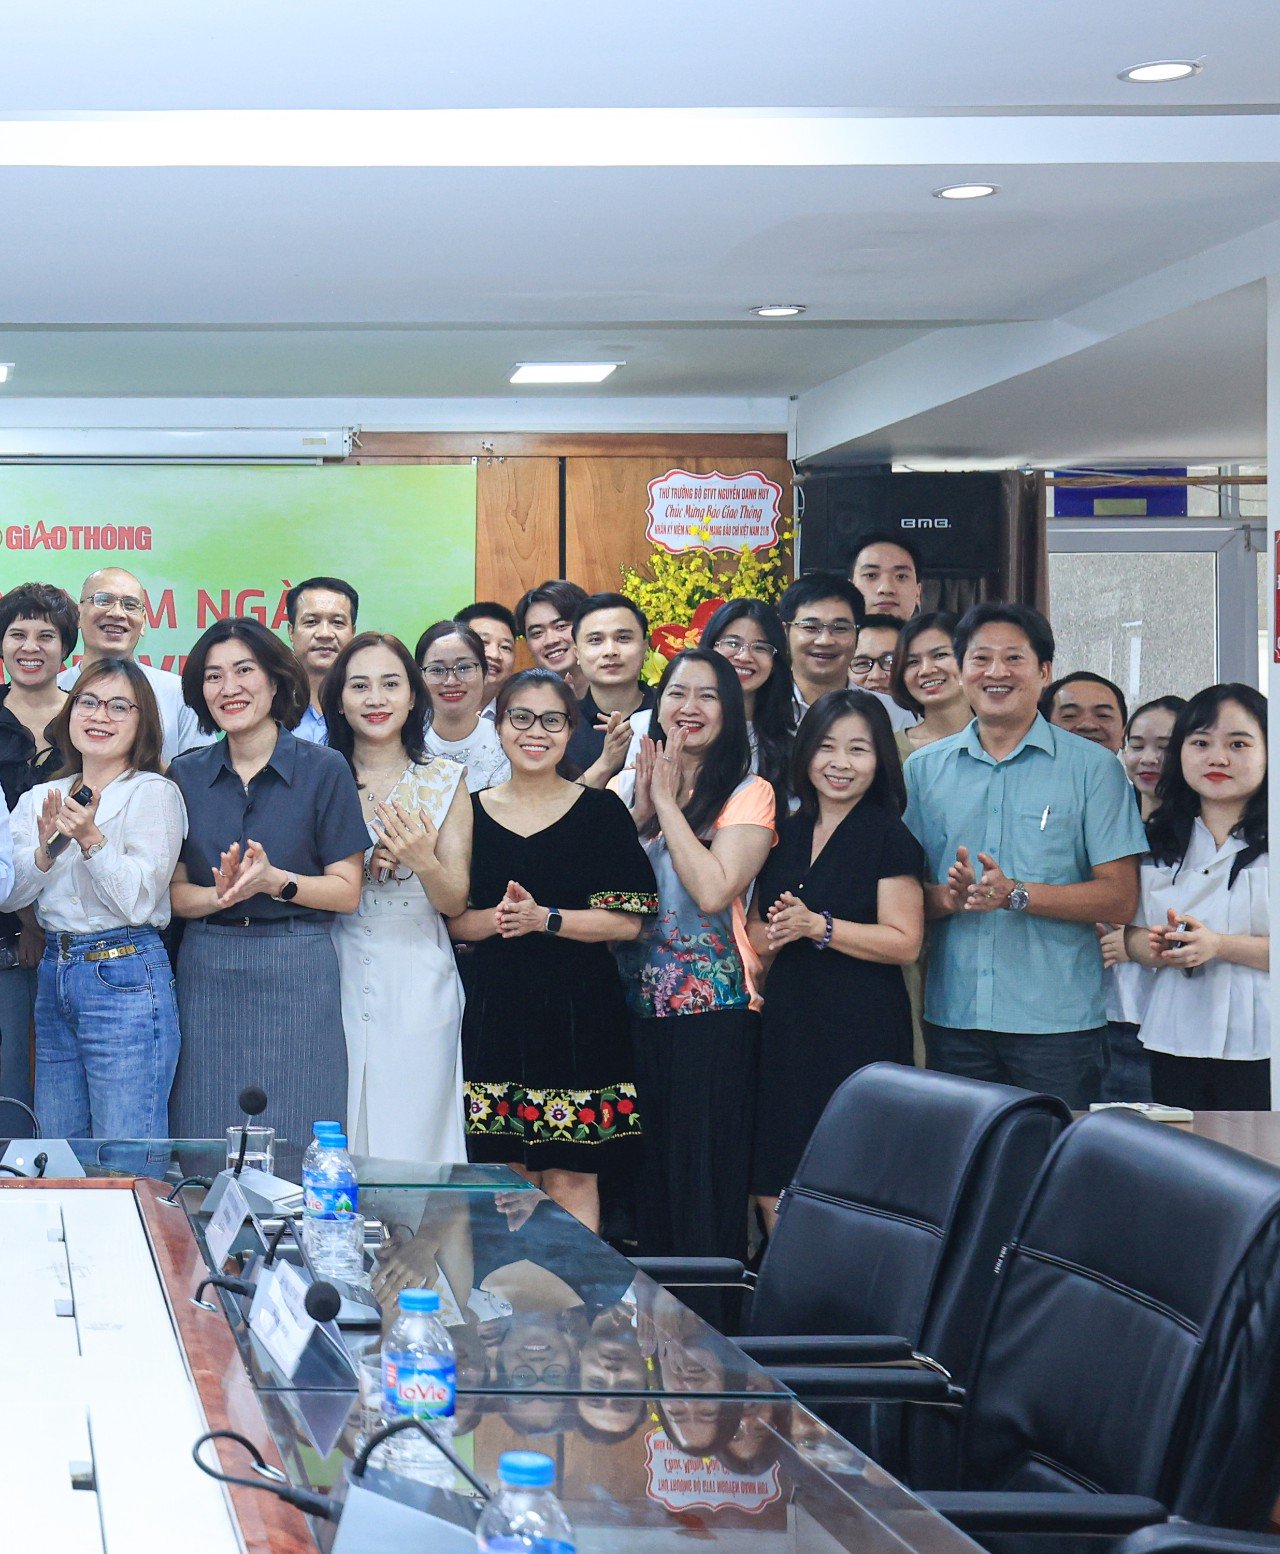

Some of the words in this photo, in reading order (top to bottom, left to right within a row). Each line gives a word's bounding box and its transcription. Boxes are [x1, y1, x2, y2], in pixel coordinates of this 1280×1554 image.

[742, 488, 757, 500] DANH
[758, 488, 770, 500] HUY
[665, 504, 683, 518] Chúc
[721, 504, 739, 519] Giao
[739, 504, 763, 522] Thông
